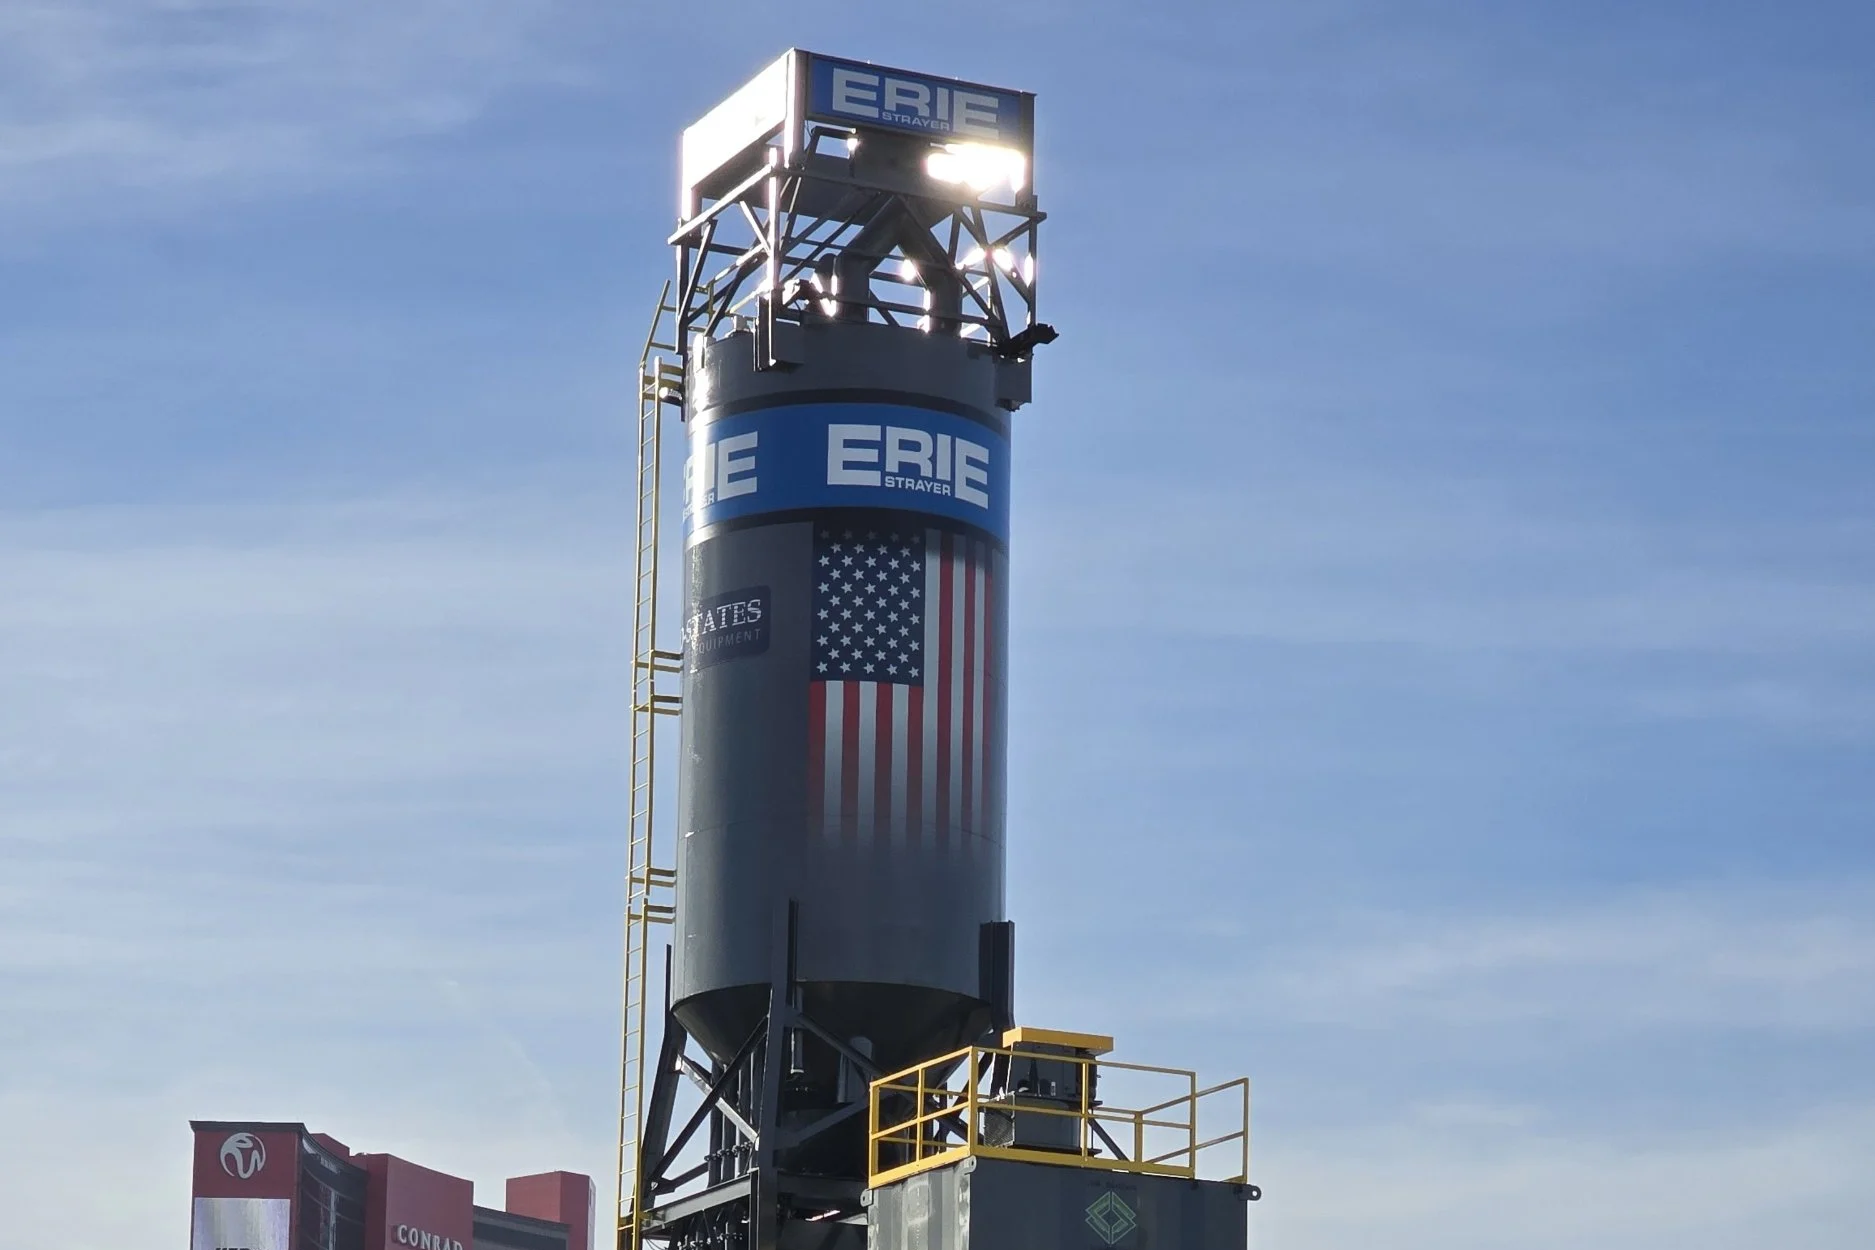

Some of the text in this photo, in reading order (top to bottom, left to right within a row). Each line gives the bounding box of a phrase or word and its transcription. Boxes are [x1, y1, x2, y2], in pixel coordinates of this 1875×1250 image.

[832, 67, 999, 140] ERIE
[882, 111, 951, 132] STRAYER
[827, 423, 989, 510] ERIE
[885, 475, 951, 497] STRAYER
